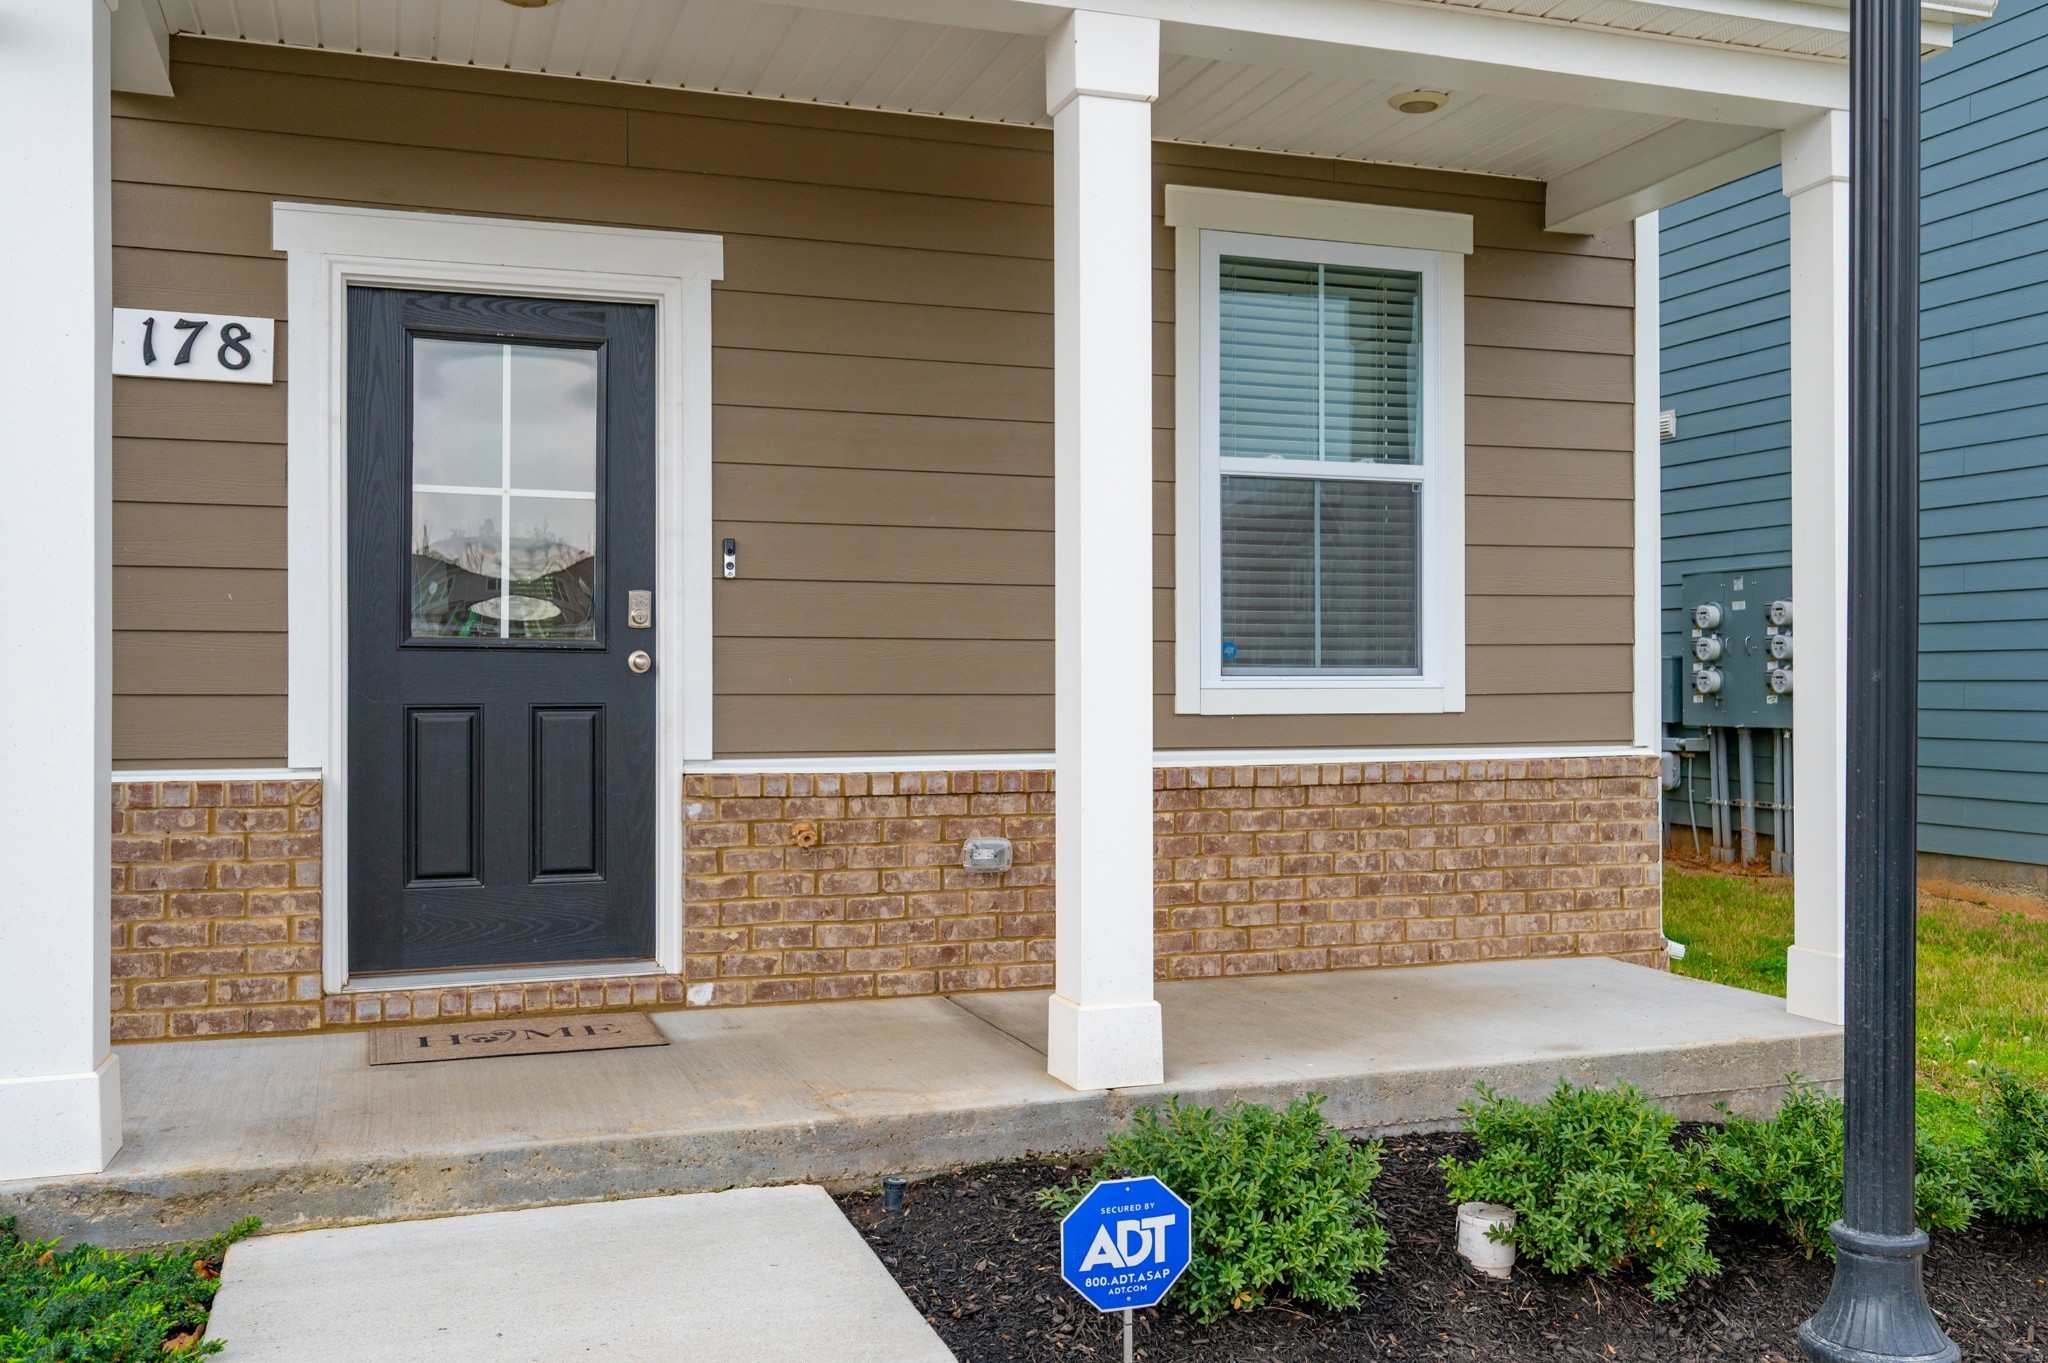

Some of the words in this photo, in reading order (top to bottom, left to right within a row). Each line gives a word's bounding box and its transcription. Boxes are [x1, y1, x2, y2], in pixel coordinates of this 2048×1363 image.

[143, 317, 251, 370] 178
[1100, 1204, 1141, 1214] SECURED
[1144, 1202, 1155, 1210] BY
[1079, 1214, 1175, 1271] ADT
[1085, 1269, 1170, 1287] 800.ADT.ASAP
[1108, 1285, 1147, 1295] ADT.COM
